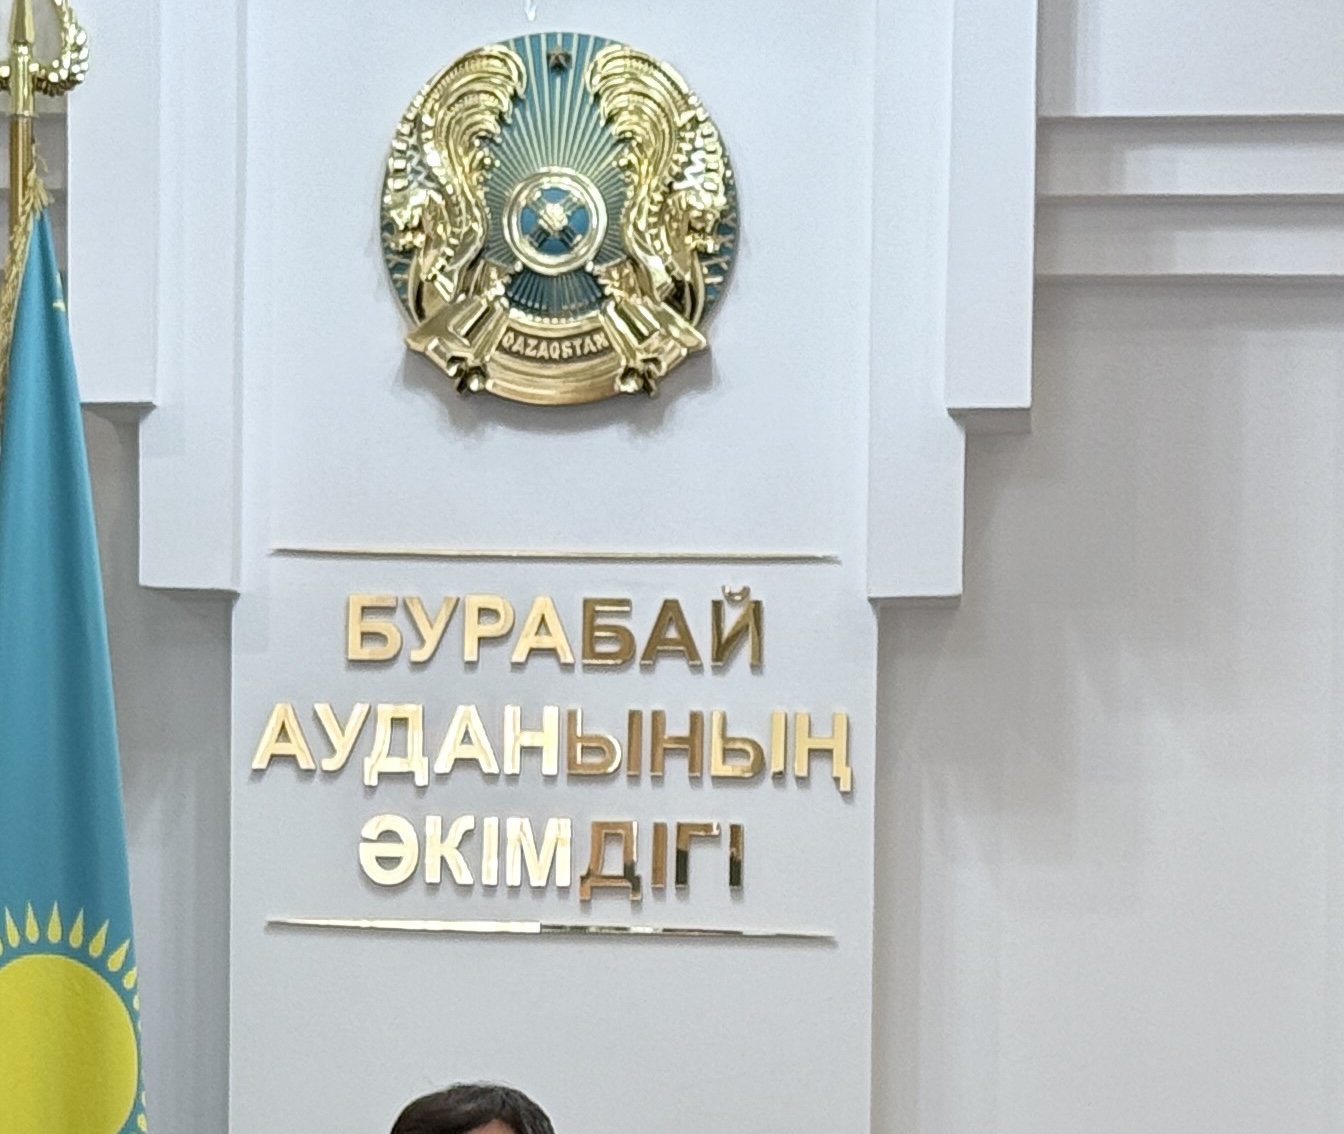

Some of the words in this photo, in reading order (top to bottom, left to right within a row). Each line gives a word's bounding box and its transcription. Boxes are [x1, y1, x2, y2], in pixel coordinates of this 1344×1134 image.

[502, 331, 610, 361] QAZAQSTAN
[346, 586, 764, 669] БУРАБАЙ
[252, 702, 852, 793] АУДАНЫНЫҢ
[358, 815, 745, 900] ӘКІМДІГІ
